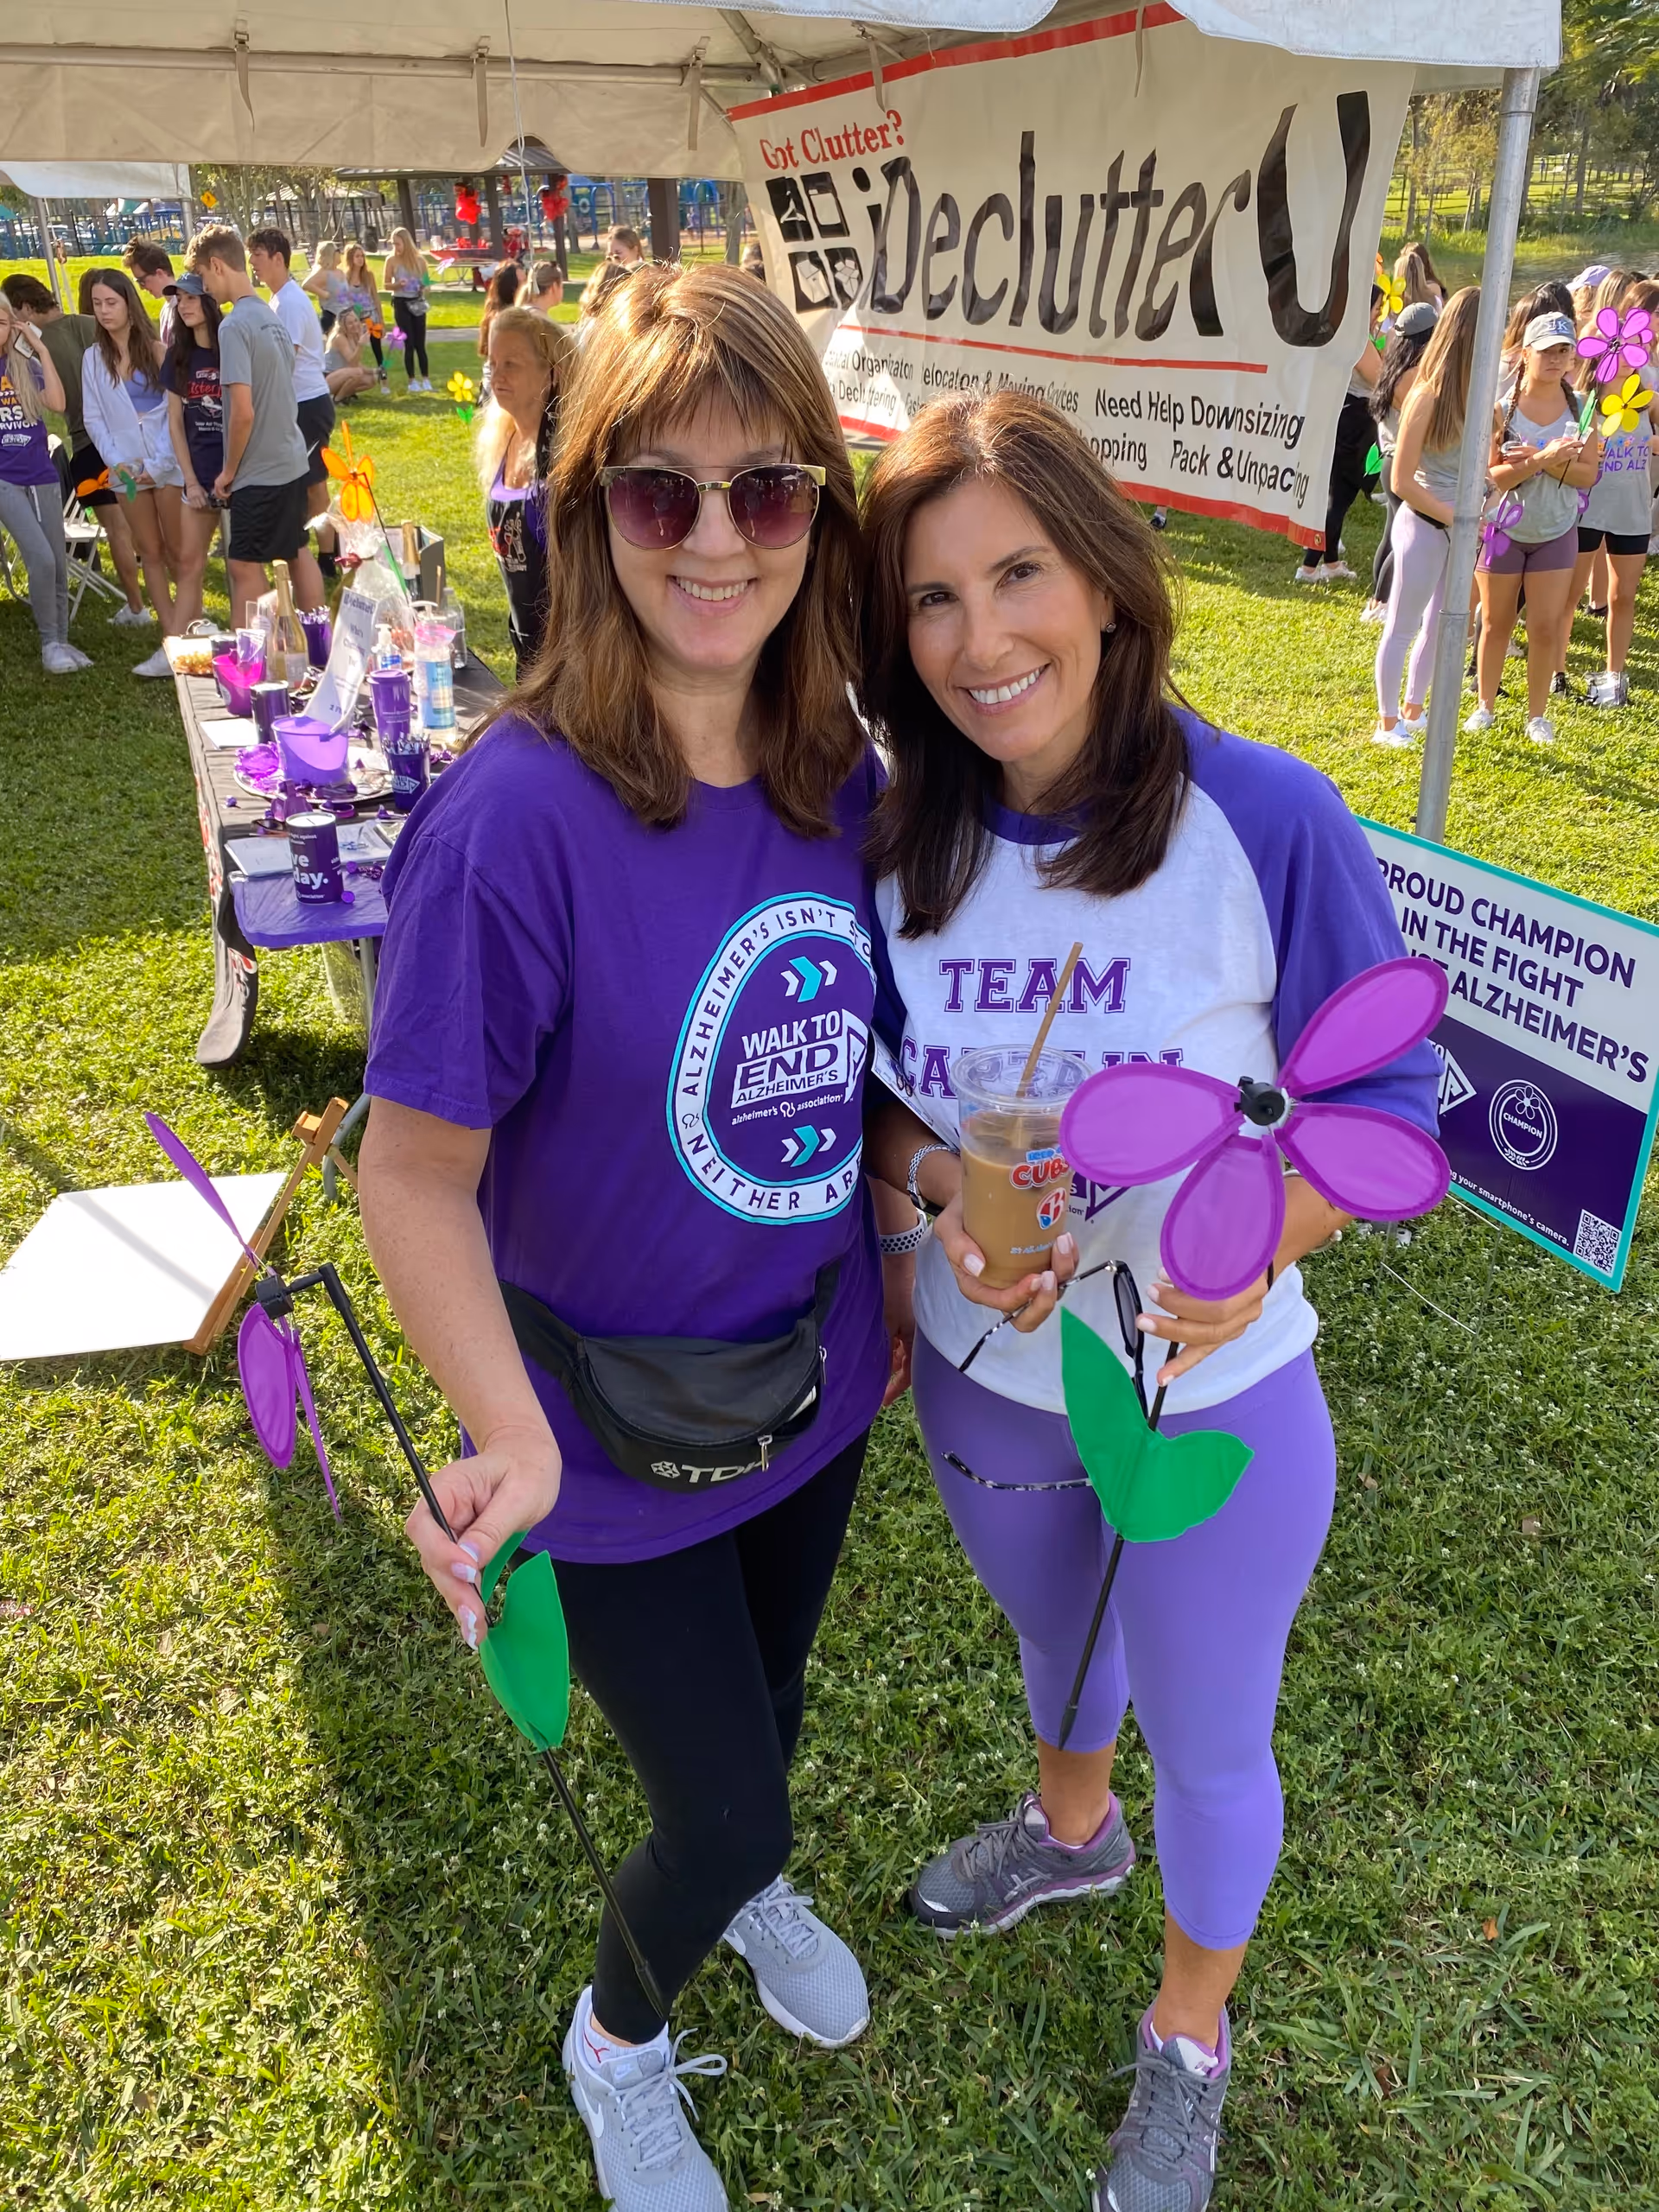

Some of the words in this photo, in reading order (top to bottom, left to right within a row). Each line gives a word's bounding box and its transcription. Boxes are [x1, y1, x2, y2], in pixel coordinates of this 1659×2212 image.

[760, 137, 799, 170] Got
[800, 109, 904, 164] Clutter?
[852, 350, 913, 380] Organizaton
[921, 363, 979, 392] elocaton
[1096, 388, 1142, 419] Need
[1147, 391, 1184, 432] Help
[1191, 395, 1306, 449] Downsizing
[1170, 439, 1211, 475] Pack
[1217, 446, 1234, 479] &
[1237, 450, 1310, 509] Unpacing
[291, 853, 309, 867] ve
[294, 867, 329, 890] day.
[1402, 906, 1428, 942] IN
[1434, 920, 1488, 968] THE
[1491, 945, 1584, 1007] FIGHT
[1471, 898, 1636, 988] CHAMPION
[682, 921, 770, 1096] ALZHEIMER'S
[775, 907, 836, 931] ISN'T
[939, 957, 1131, 1014] TEAM
[741, 1019, 808, 1060] WALK
[810, 1010, 841, 1039] TO
[1451, 970, 1649, 1083] ALZHEIMER'S
[735, 1069, 838, 1105] ALZHEIMER'S
[738, 1043, 838, 1090] END
[732, 1106, 778, 1125] alzheimer's
[1503, 1112, 1543, 1139] CHAMPION
[686, 1133, 801, 1211] NEITHER
[1459, 1173, 1478, 1192] your
[1478, 1185, 1535, 1225] smartphone's
[1536, 1219, 1570, 1247] camera.
